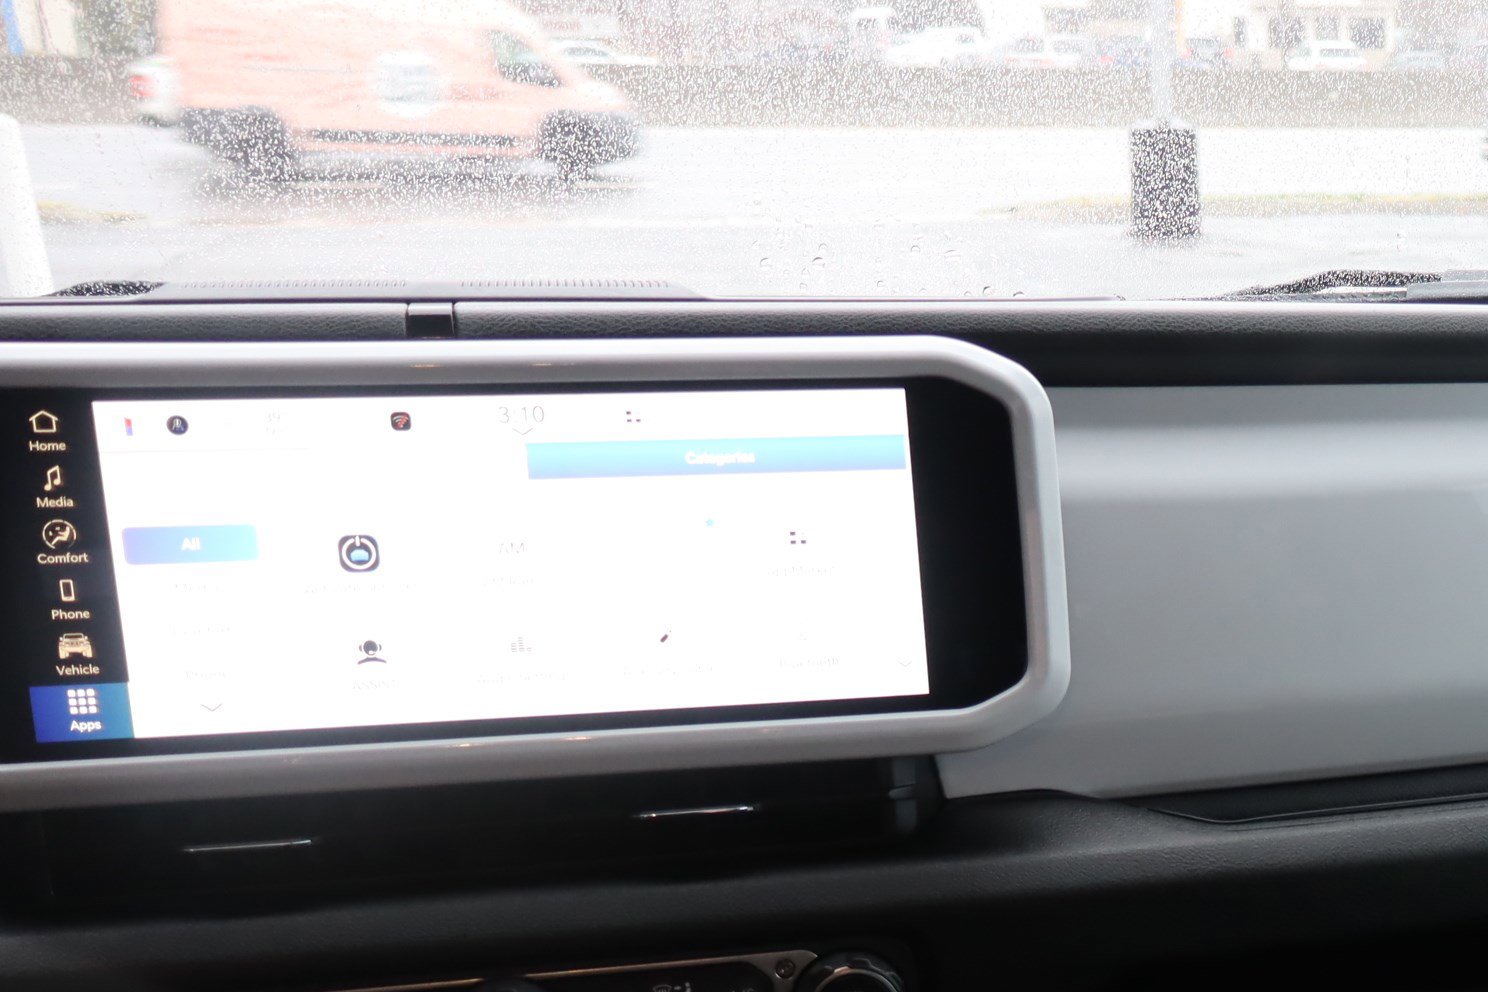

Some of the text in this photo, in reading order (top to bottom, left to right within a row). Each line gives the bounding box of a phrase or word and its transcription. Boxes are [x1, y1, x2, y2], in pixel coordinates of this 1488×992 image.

[29, 441, 66, 451] Home
[36, 497, 74, 508] Media
[181, 537, 200, 551] All
[37, 552, 88, 564] Comfort
[51, 609, 90, 620] Phone
[56, 664, 100, 676] Vehicle
[70, 720, 102, 732] Apps
